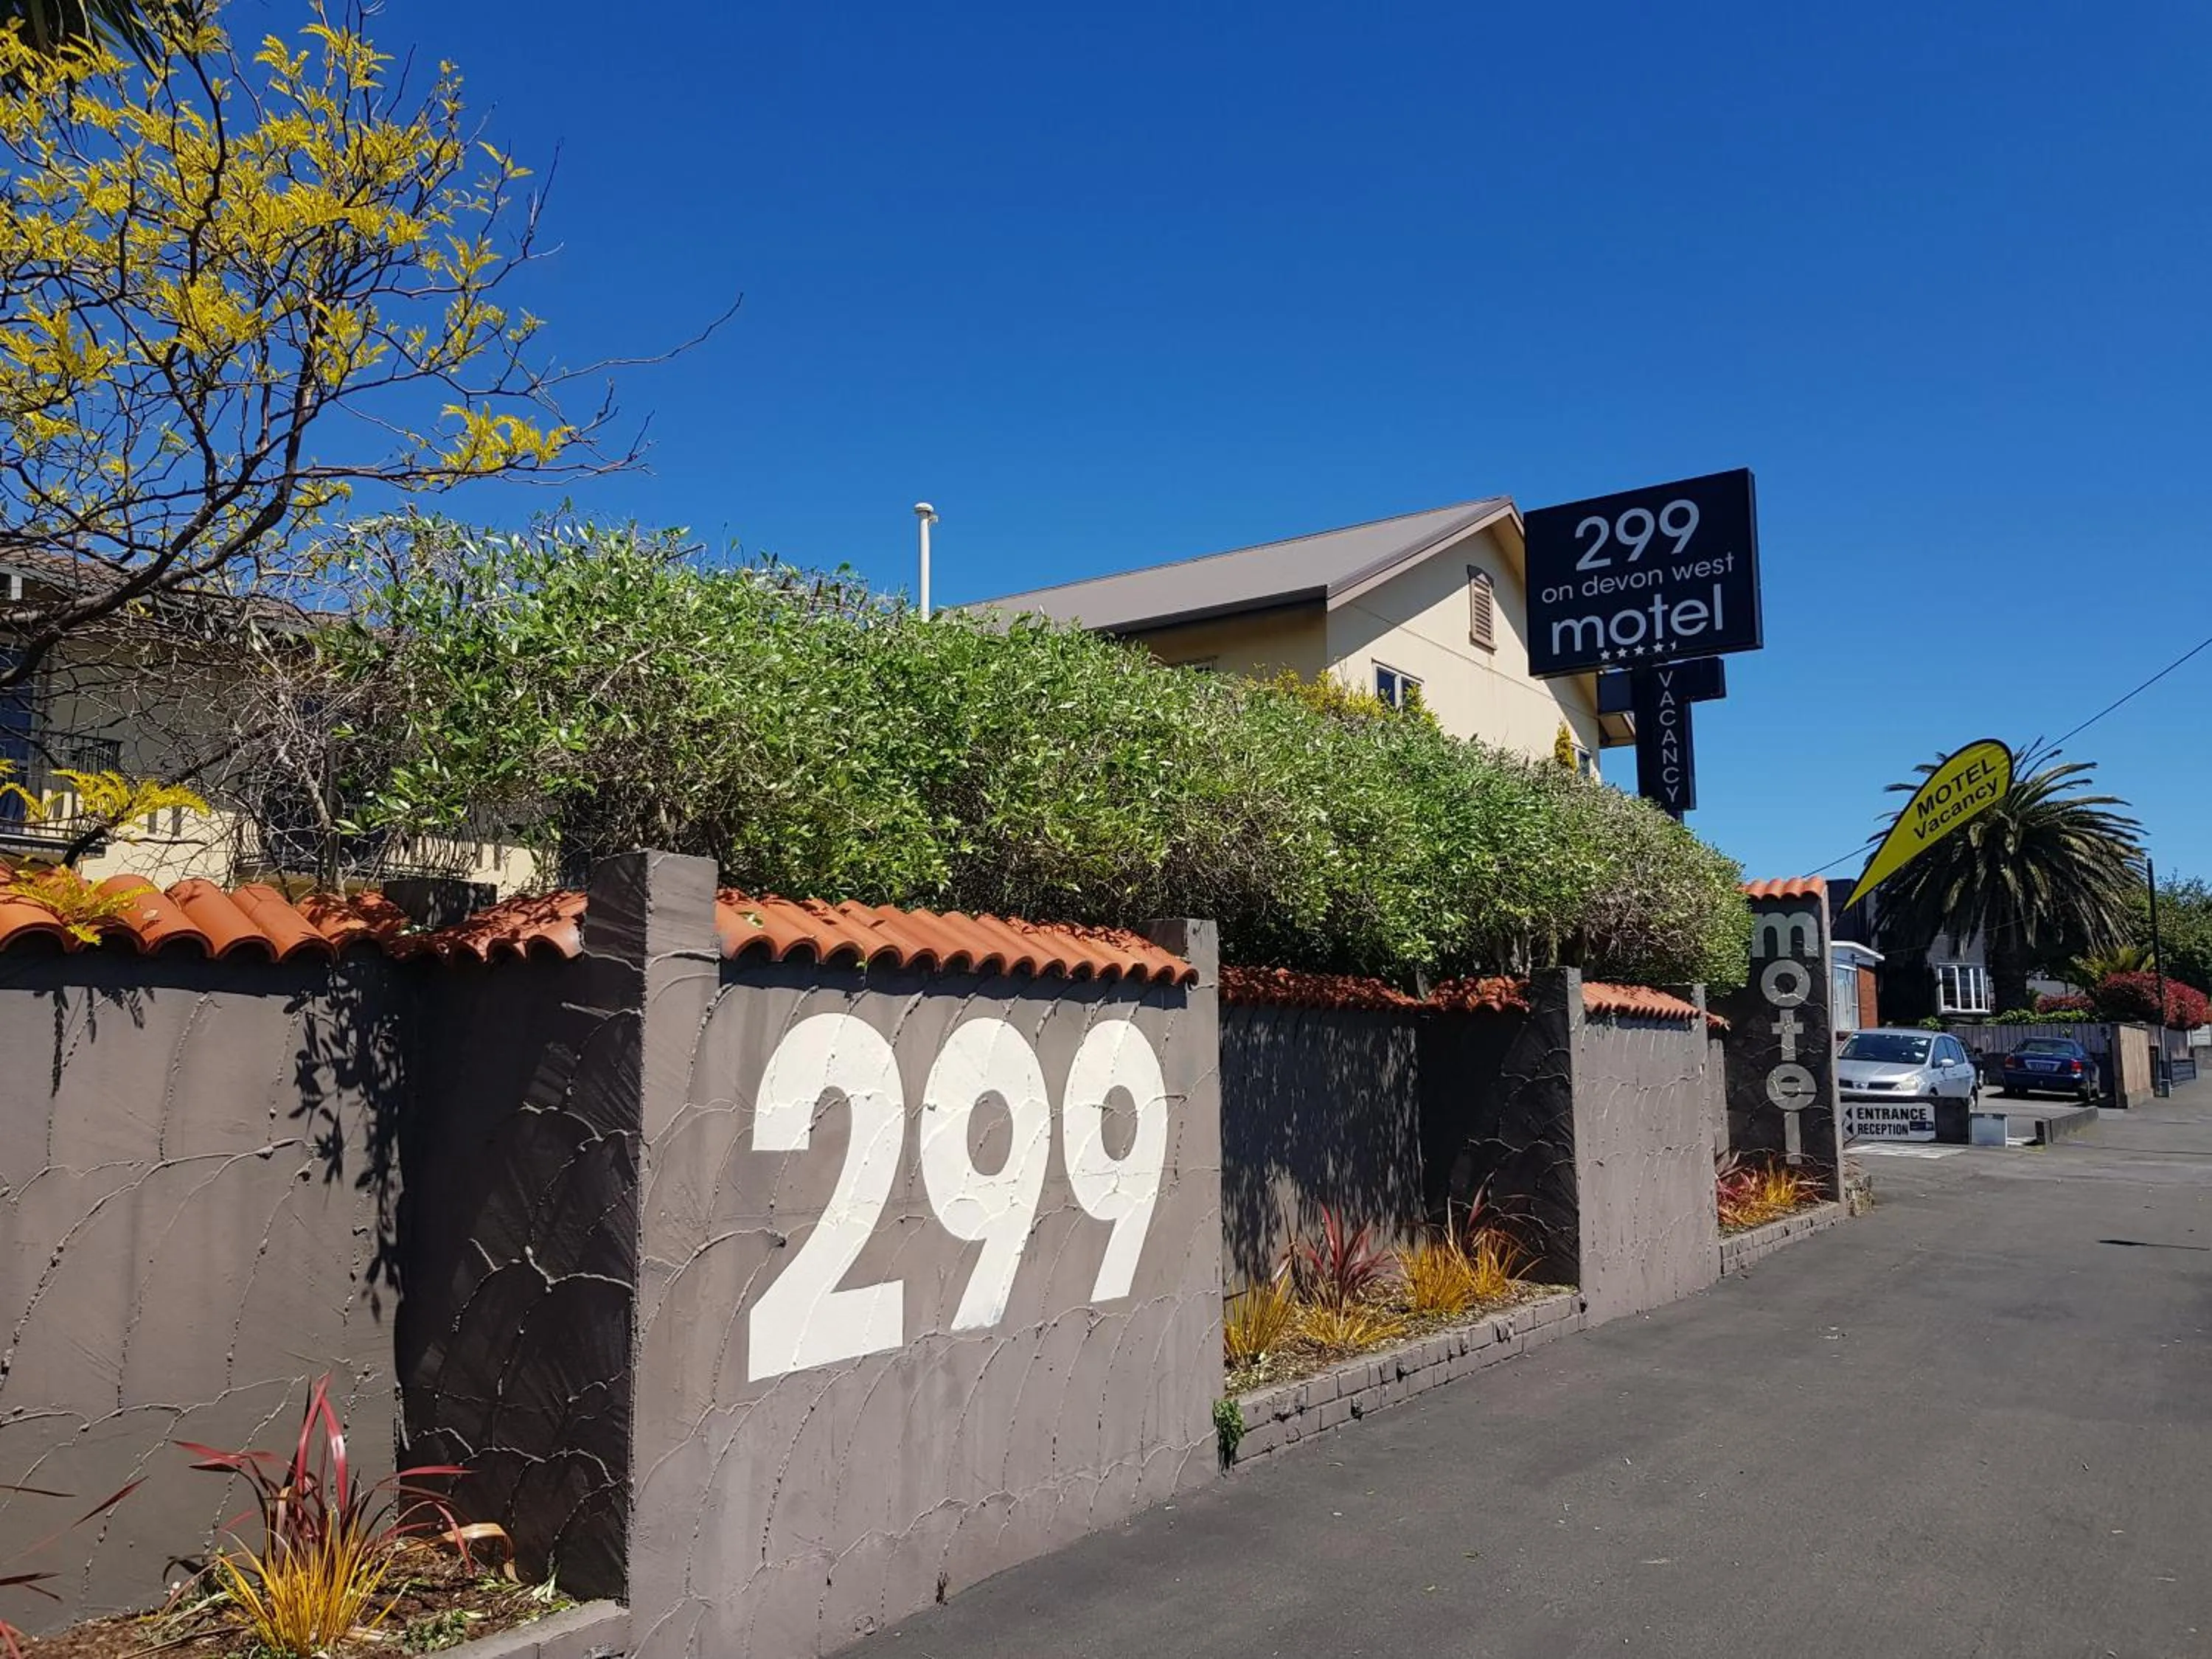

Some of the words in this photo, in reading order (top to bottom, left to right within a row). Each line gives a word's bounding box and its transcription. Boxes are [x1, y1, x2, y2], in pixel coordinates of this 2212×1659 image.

[1574, 499, 1700, 571] 299
[1542, 585, 1573, 603] on
[1582, 568, 1663, 597] devon
[1672, 552, 1735, 581] west
[1552, 584, 1723, 655] motel
[1659, 671, 1680, 803] VACANCY
[1917, 759, 1997, 818] MOTEL
[1753, 911, 1820, 1165] motel
[1857, 1108, 1927, 1120] ENTRANCE
[1857, 1123, 1909, 1135] RECEPTION
[748, 1012, 1168, 1383] 299
